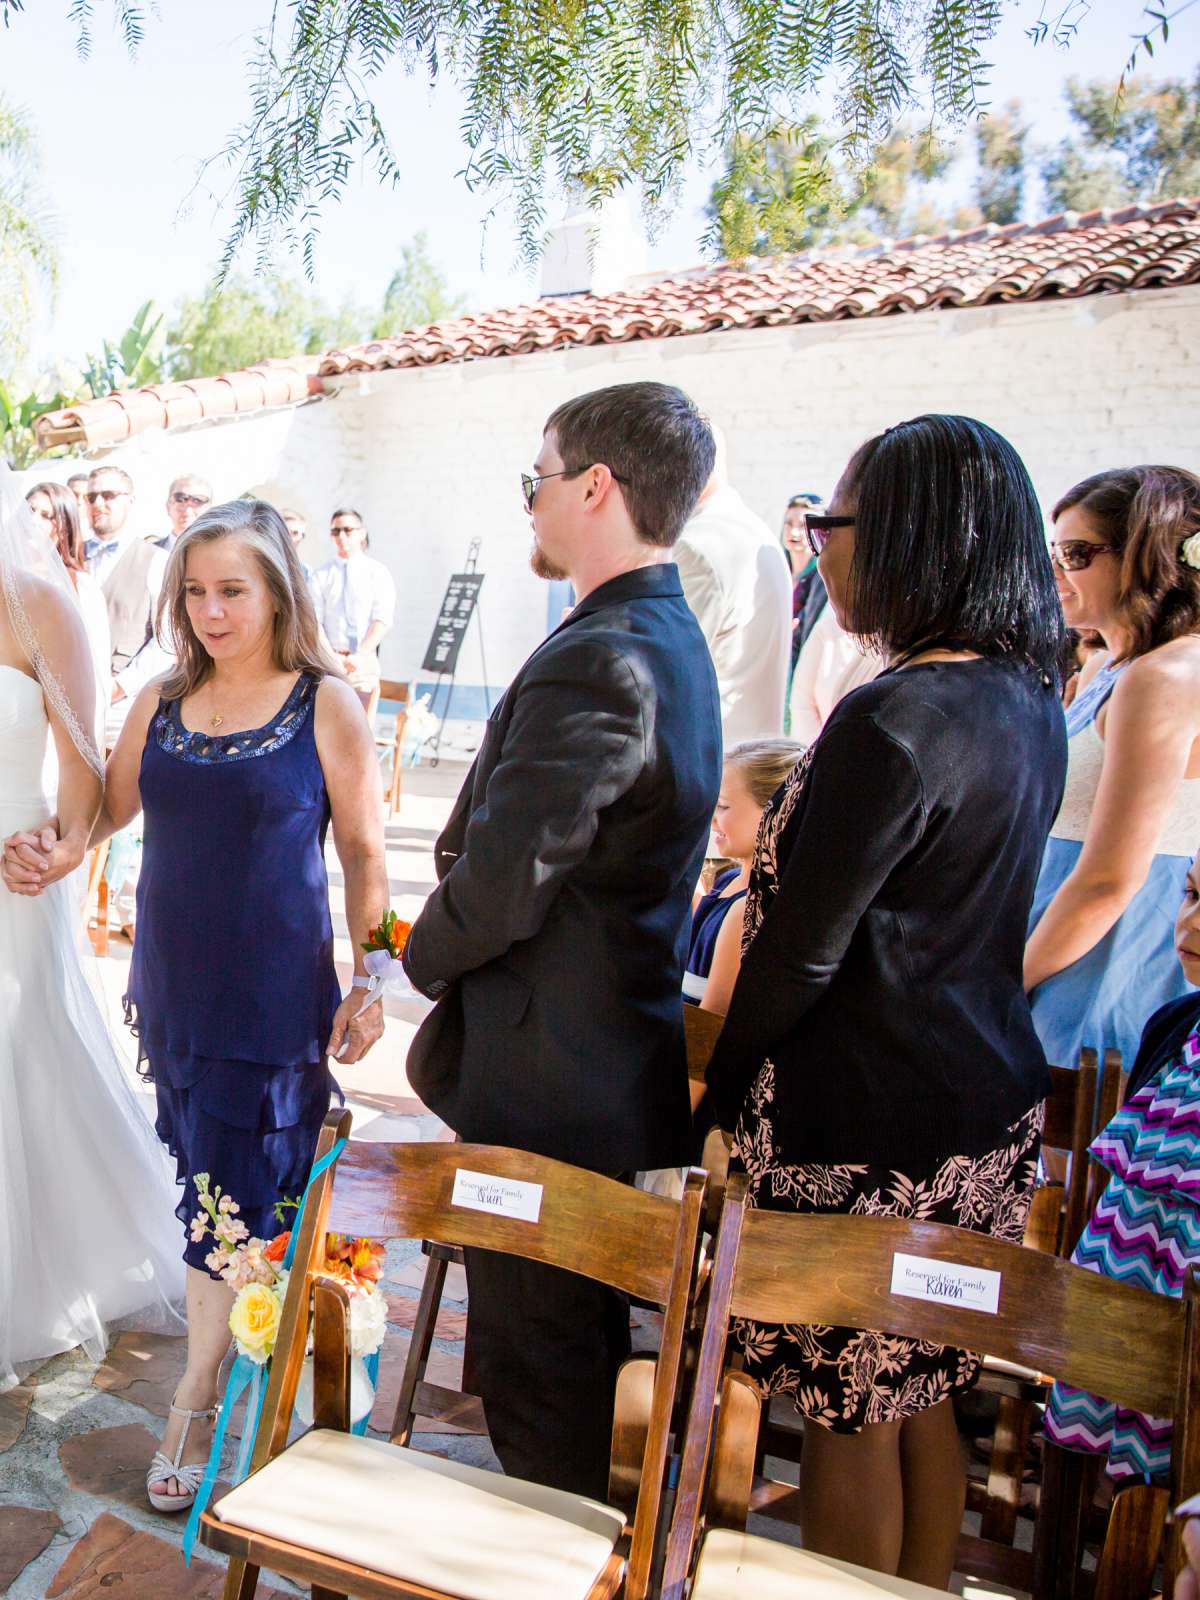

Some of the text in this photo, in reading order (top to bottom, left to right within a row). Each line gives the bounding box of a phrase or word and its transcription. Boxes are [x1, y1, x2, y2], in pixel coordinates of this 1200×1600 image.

[460, 1179, 523, 1200] Reserved for Family
[905, 1267, 987, 1292] Reserved for Family
[926, 1276, 963, 1298] Karen
